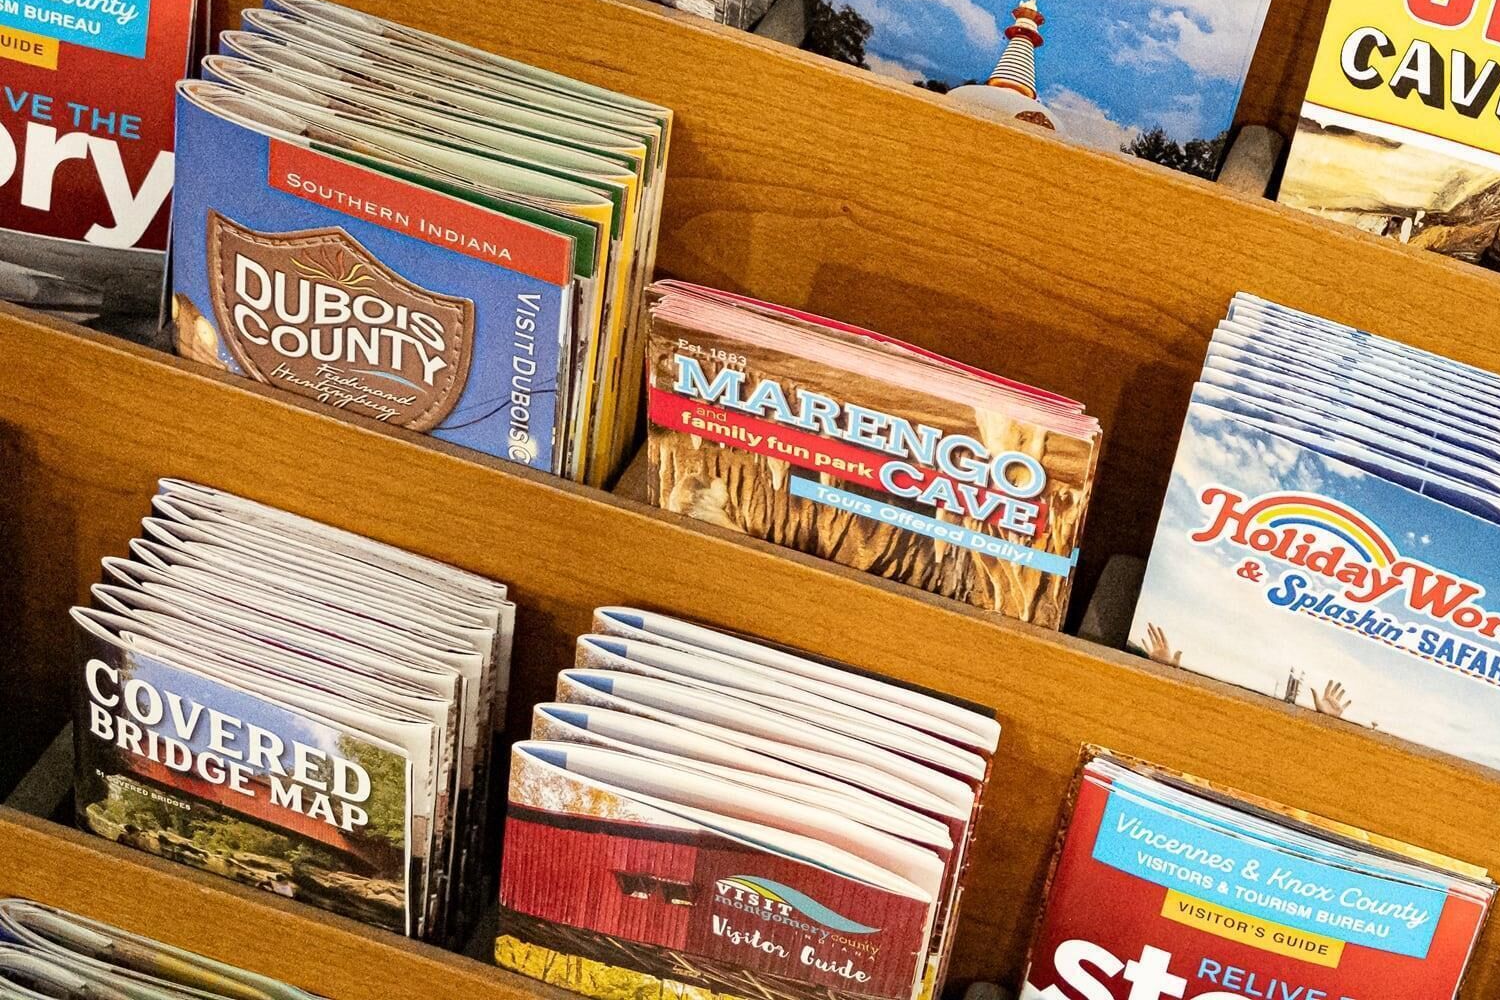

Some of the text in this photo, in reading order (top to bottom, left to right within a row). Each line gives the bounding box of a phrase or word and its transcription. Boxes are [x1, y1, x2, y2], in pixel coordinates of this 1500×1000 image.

[24, 5, 101, 35] BUREAU
[67, 102, 141, 140] THE
[286, 172, 512, 261] SOUTHERN INDIANA
[235, 252, 447, 354] DUBOIS
[233, 303, 447, 386] COUNTY
[677, 337, 748, 367] Est. 1883
[271, 362, 401, 420] Huntingburg
[315, 363, 417, 407] Ferdinand
[696, 406, 727, 422] and
[673, 353, 1046, 499] MARENGO
[681, 411, 874, 480] family fun park
[816, 486, 1034, 566] Tours Offered Daily!
[879, 460, 1039, 537] CAVE
[1192, 488, 1404, 603] Holiday
[1237, 560, 1264, 583] &
[1267, 574, 1417, 642] Splashin'
[85, 659, 372, 803] COVERED
[89, 701, 369, 832] BRIDGE MAP
[151, 792, 191, 811] BRIDGES
[716, 883, 792, 916] VISIT
[1115, 813, 1431, 929] Vincennes & Knox County
[1137, 851, 1391, 938] VISITORS & TOURISM BUREAU
[713, 914, 871, 983] Visitor Guide
[1178, 901, 1330, 957] VISITOR'S GUIDE
